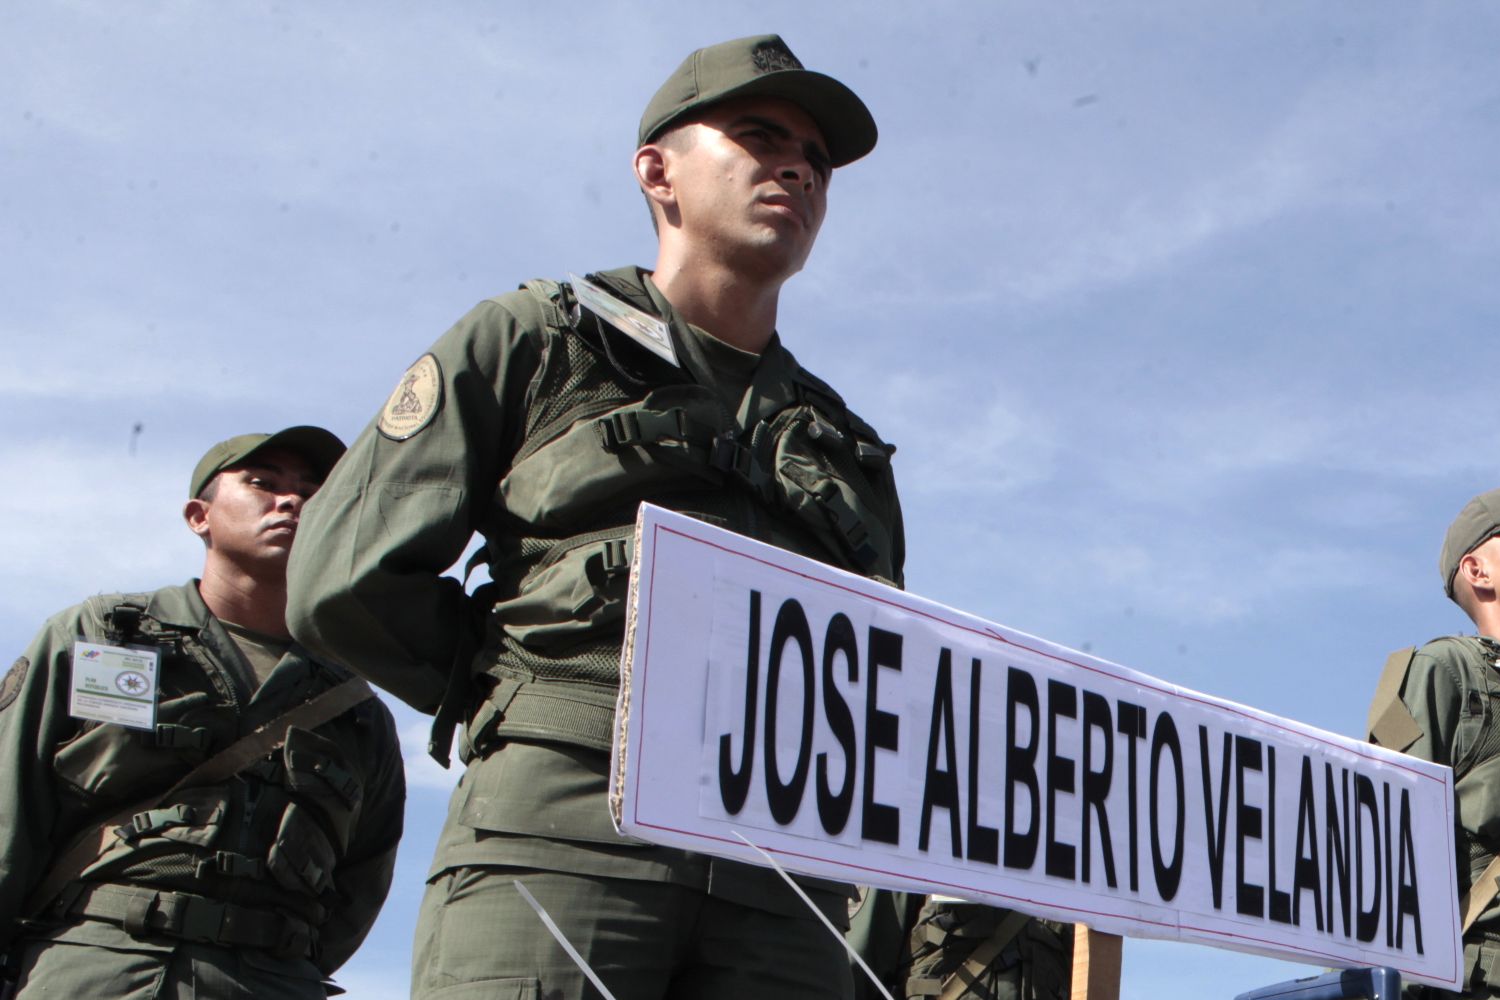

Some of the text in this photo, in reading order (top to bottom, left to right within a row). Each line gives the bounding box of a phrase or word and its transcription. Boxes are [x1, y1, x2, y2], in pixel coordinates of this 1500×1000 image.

[718, 589, 1424, 955] JOSE ALBERTO VELANDIA
